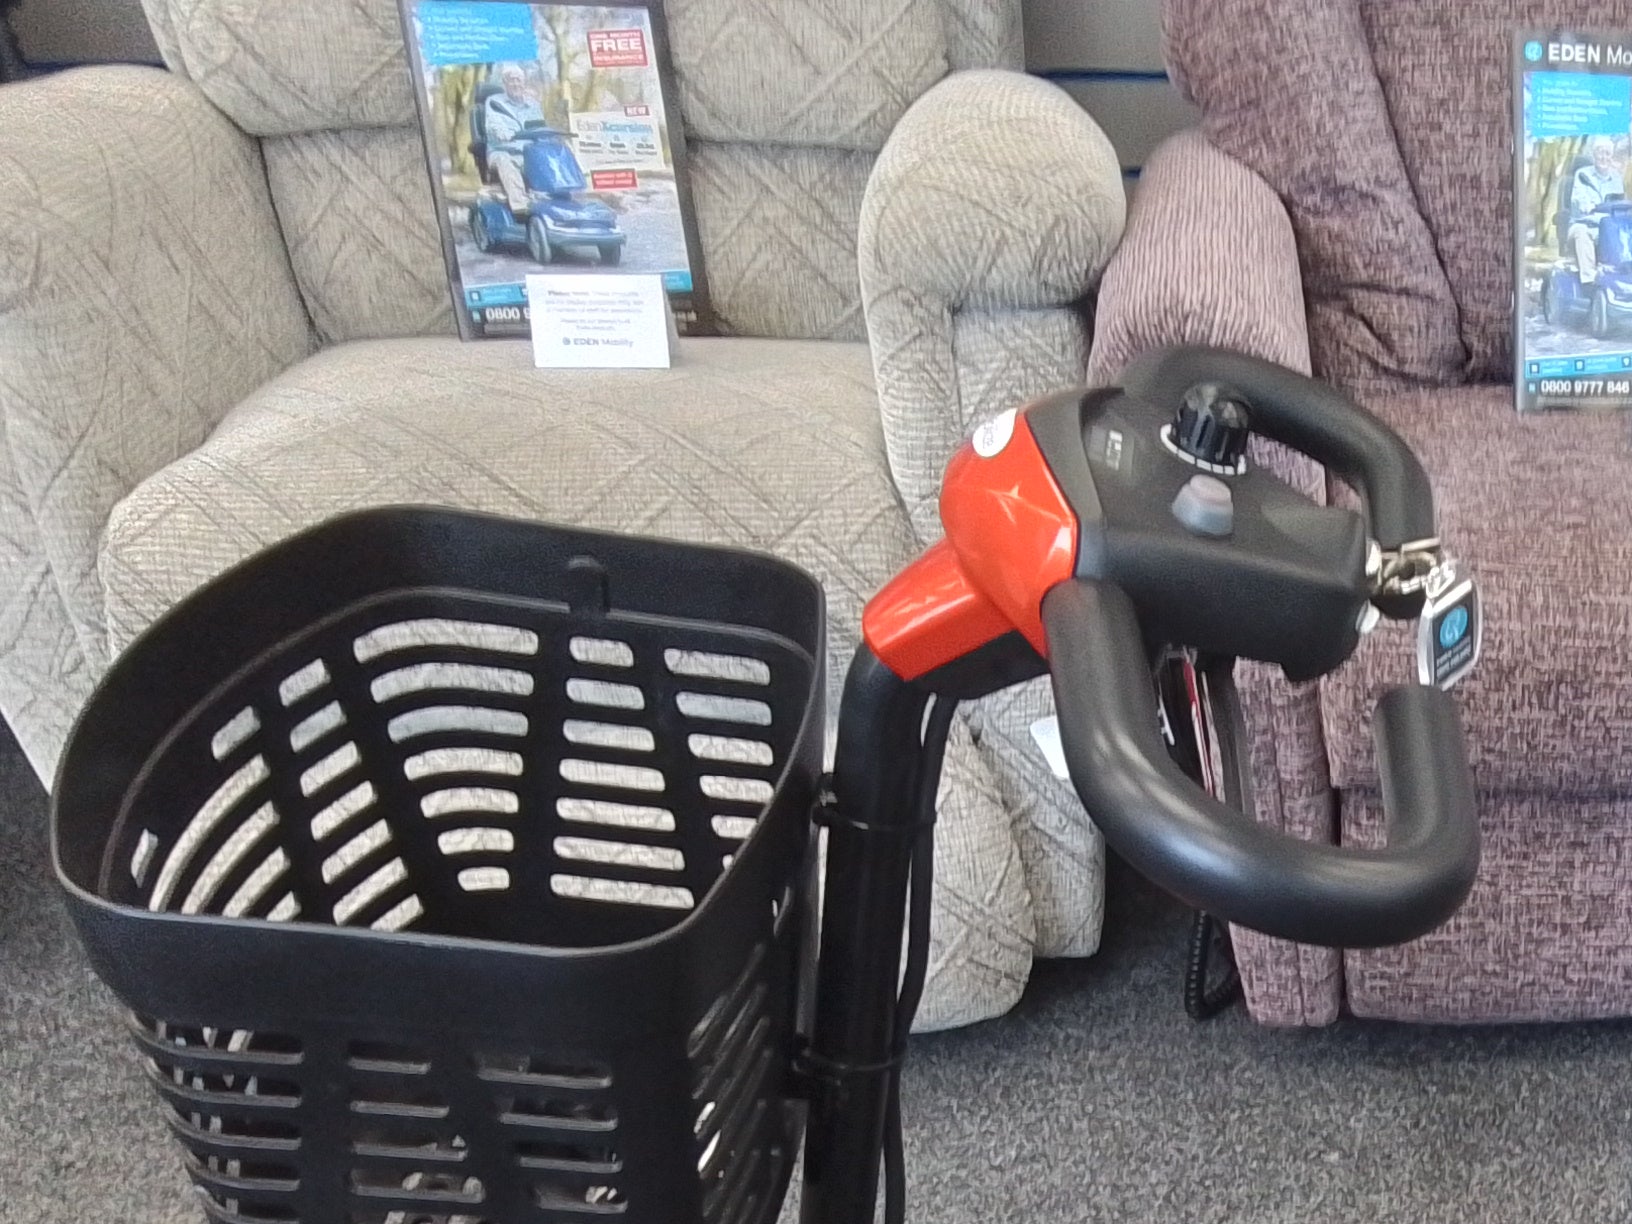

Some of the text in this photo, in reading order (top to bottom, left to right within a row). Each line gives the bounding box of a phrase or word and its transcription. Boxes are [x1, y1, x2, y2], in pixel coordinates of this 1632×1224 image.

[591, 38, 643, 51] FREE
[1548, 43, 1601, 63] EDEN
[486, 306, 521, 321] 0800
[1541, 380, 1572, 393] 0800
[1574, 380, 1604, 395] 9777
